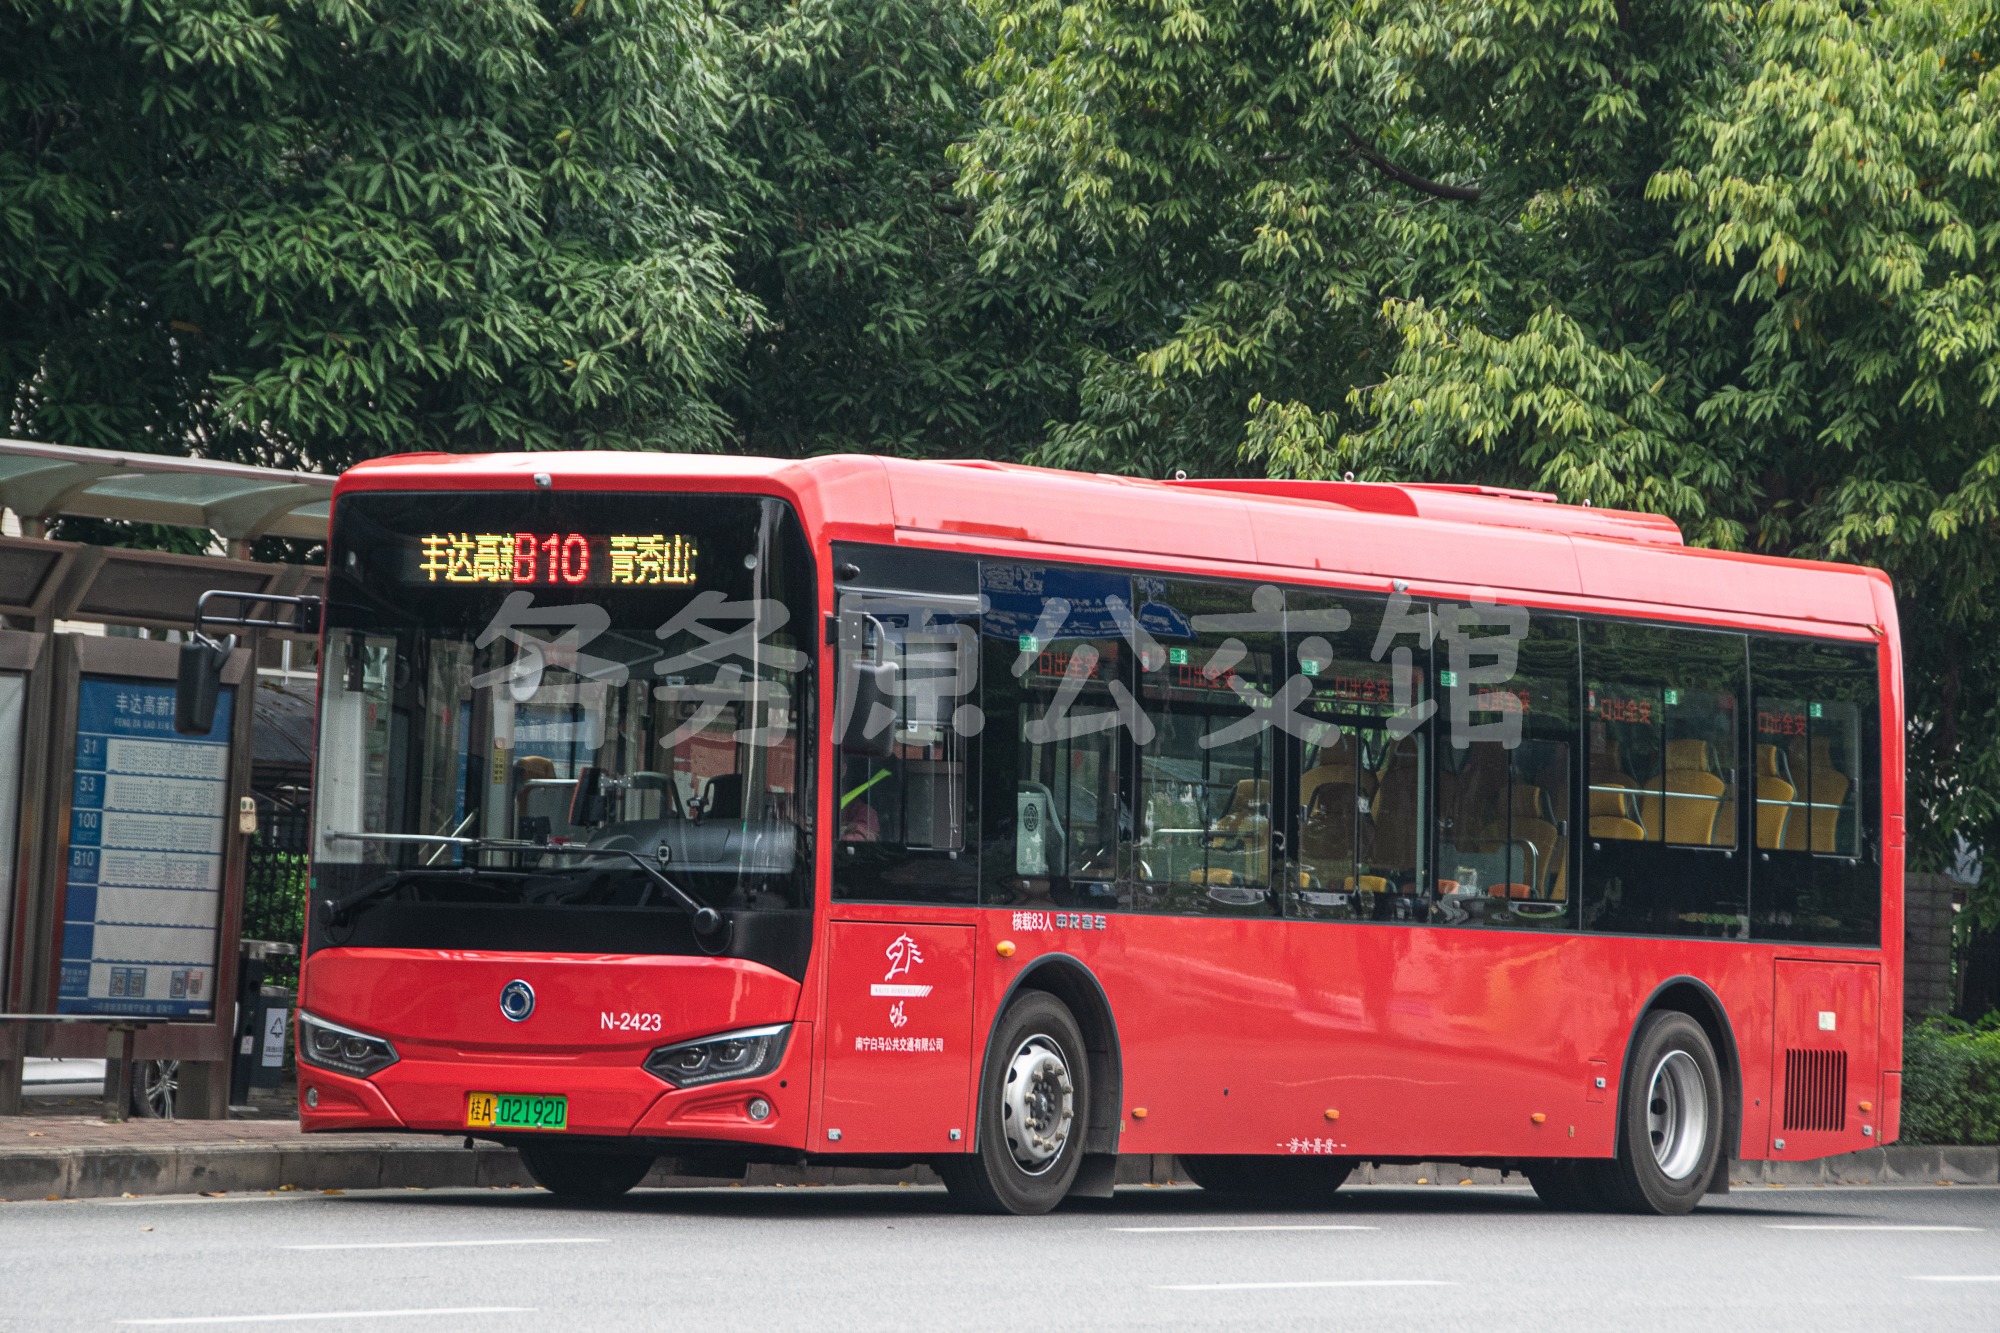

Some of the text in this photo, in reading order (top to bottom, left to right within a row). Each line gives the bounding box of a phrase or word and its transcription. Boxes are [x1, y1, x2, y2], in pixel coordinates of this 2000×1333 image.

[513, 533, 588, 583] B10
[609, 534, 688, 583] 青秀山
[83, 738, 98, 754] 31
[79, 776, 96, 792] 53
[78, 813, 97, 829] 100
[74, 851, 94, 866] B10
[1012, 911, 1053, 932] 核载83人
[600, 1012, 662, 1032] N-2423
[855, 1036, 944, 1052] 南宁白马公共交通有限公司
